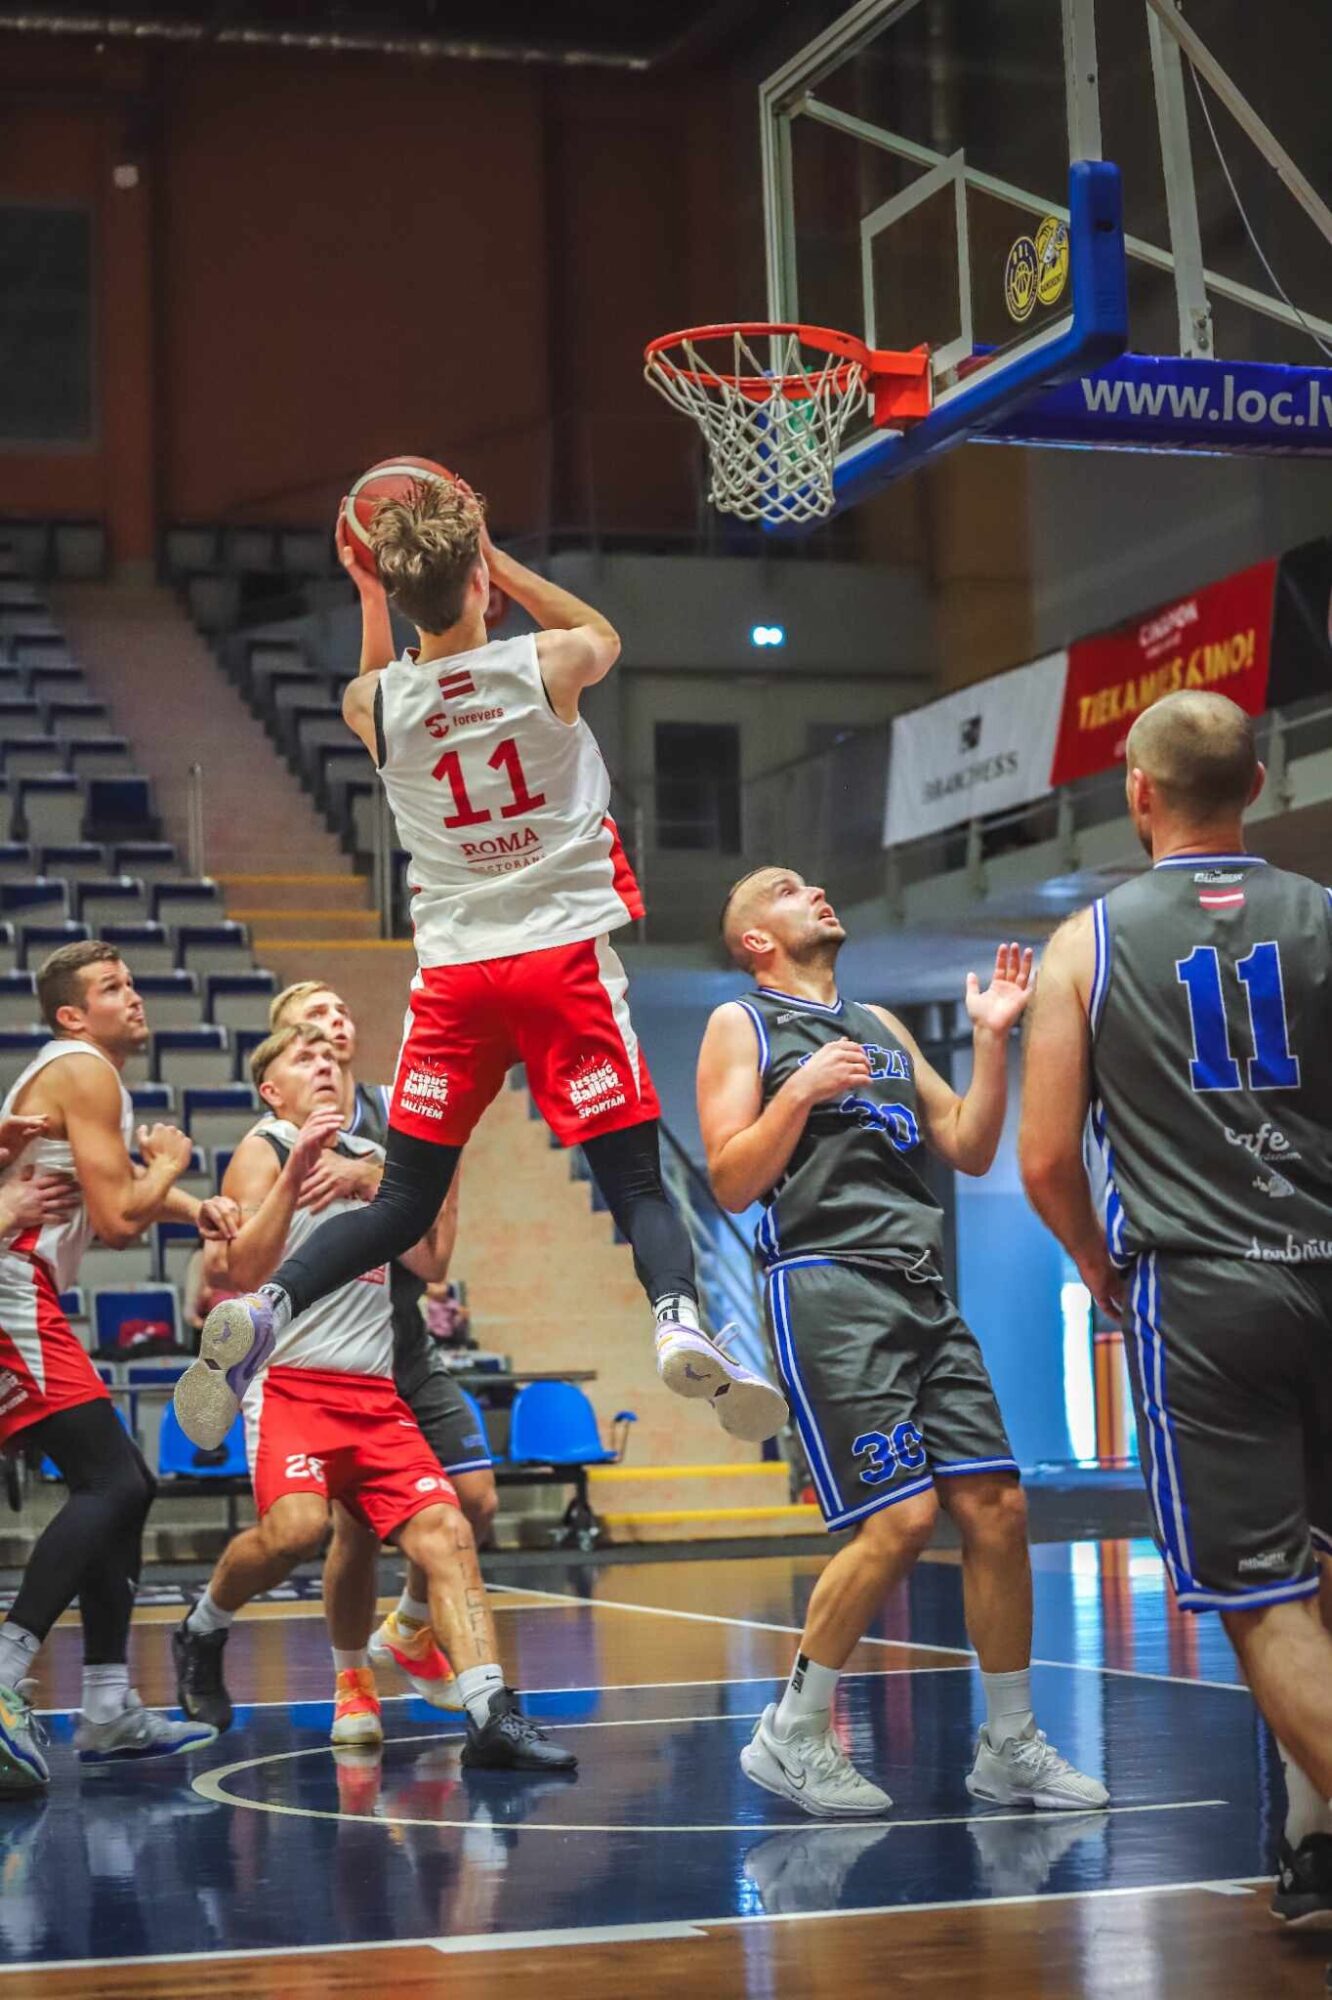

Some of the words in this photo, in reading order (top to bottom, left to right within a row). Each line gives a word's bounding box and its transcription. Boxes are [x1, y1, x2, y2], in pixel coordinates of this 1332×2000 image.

[431, 738, 546, 829] 11
[461, 827, 539, 857] ROMA
[1175, 940, 1300, 1092] 11
[578, 1093, 626, 1119] SPORTAM
